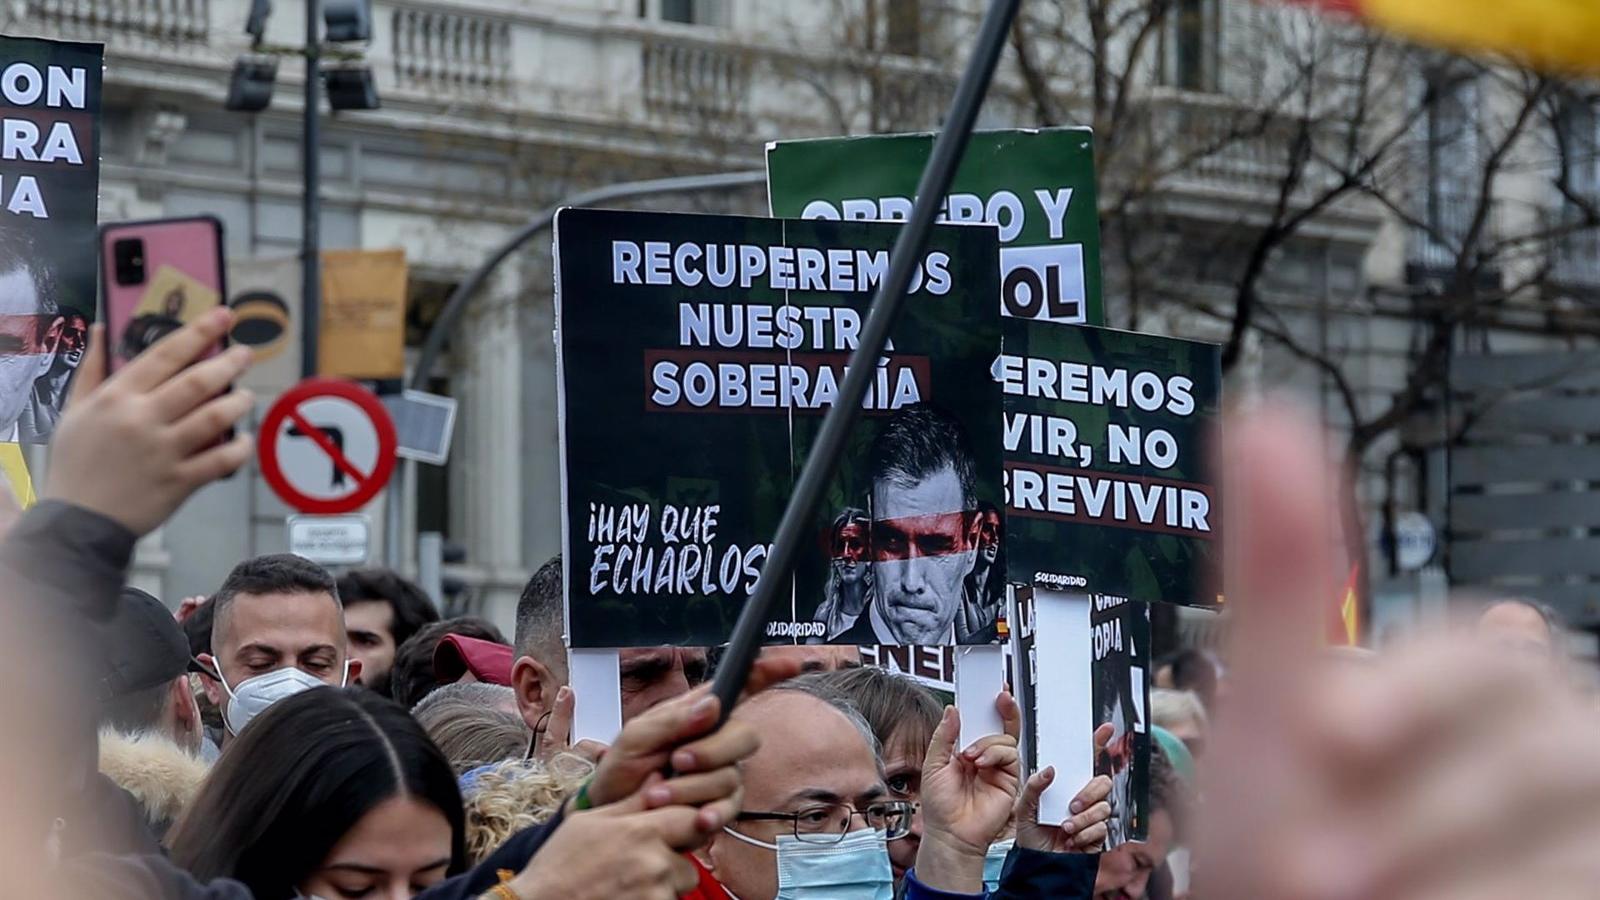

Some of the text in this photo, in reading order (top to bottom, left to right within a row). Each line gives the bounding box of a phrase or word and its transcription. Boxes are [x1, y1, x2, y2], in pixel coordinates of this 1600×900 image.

[0, 175, 49, 218] A
[1034, 187, 1074, 240] Y
[679, 302, 895, 351] NUESTR
[1108, 424, 1178, 469] NO
[661, 504, 720, 544] QUE
[1034, 570, 1088, 588] SOLIDARIDAD
[766, 620, 826, 637] OLIDARIDAD
[1090, 617, 1123, 661] ORIA
